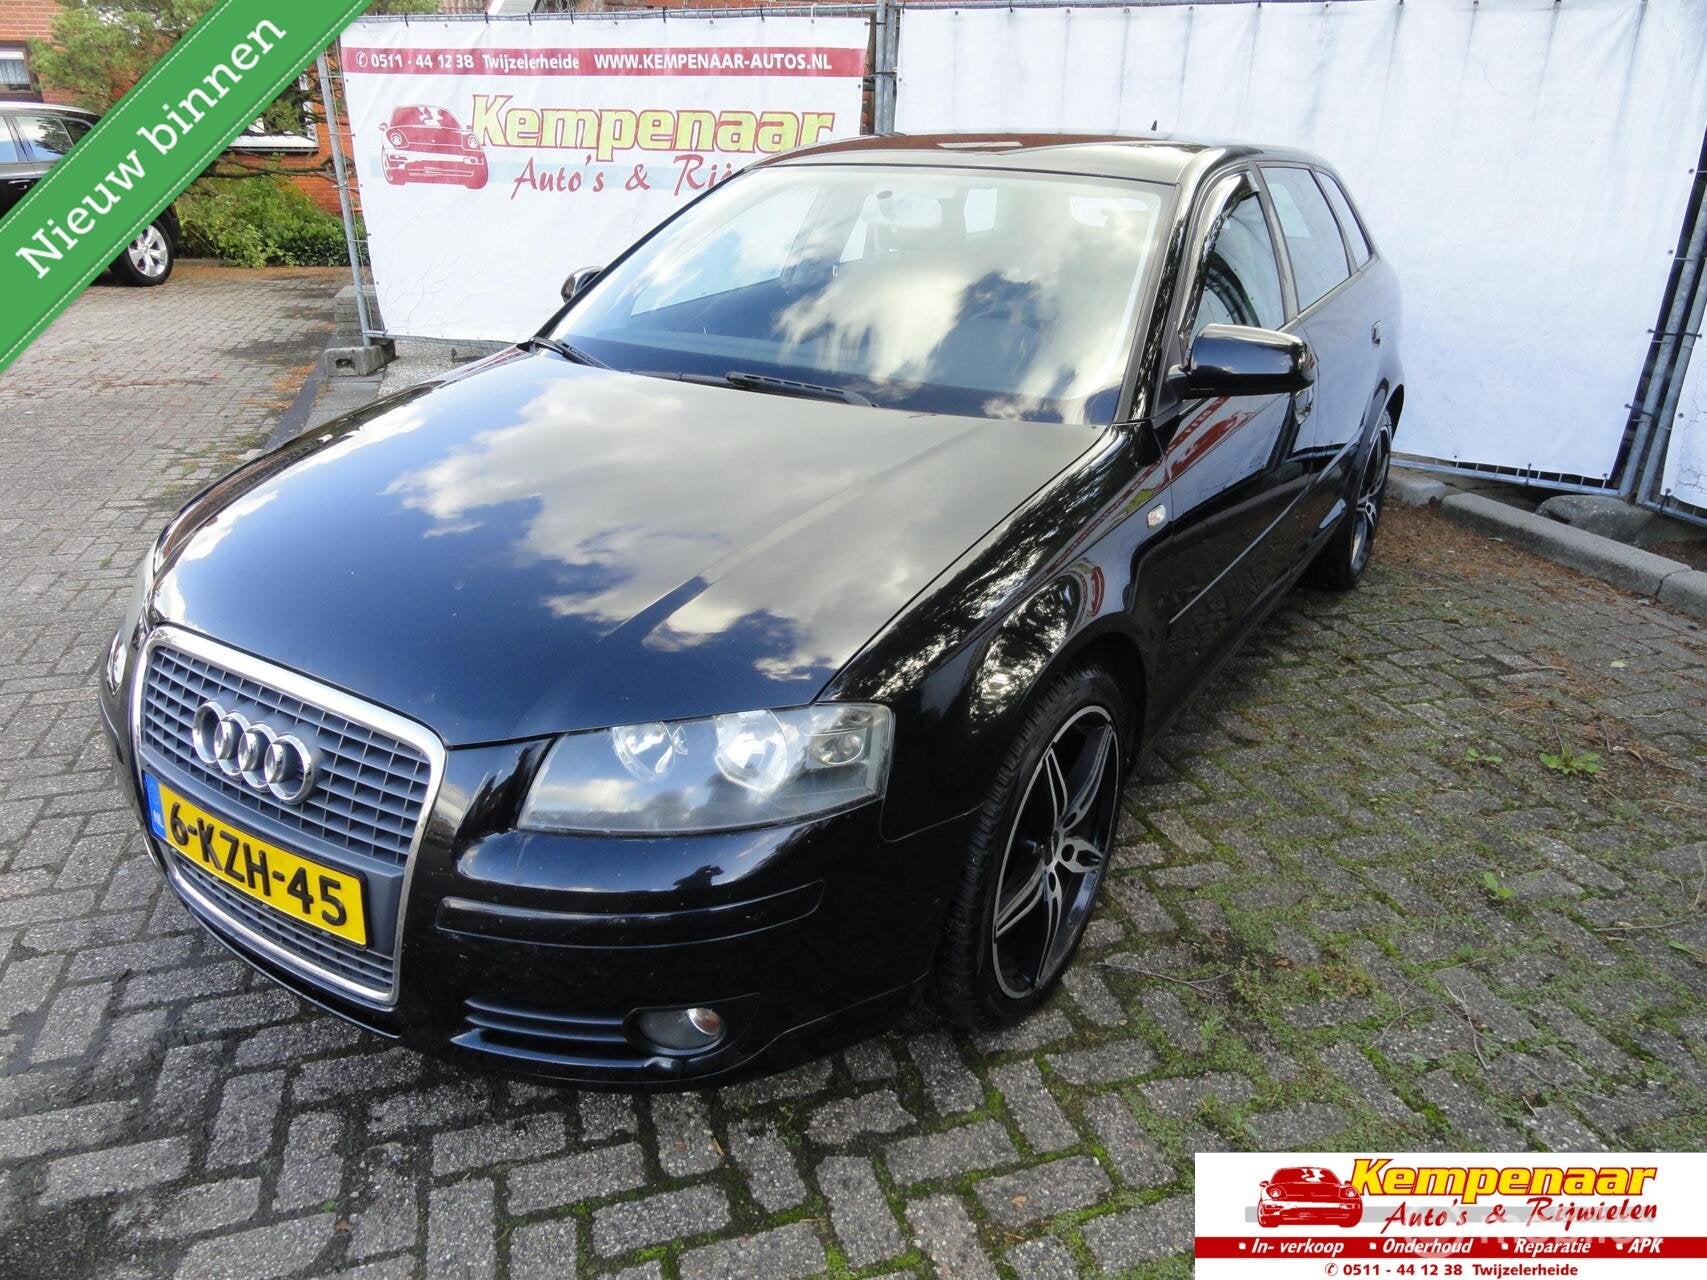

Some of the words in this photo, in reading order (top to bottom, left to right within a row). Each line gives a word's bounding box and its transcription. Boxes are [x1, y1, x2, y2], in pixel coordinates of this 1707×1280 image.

[371, 54, 403, 68] 0511
[415, 54, 433, 68] 44
[437, 55, 452, 68] 12
[456, 54, 474, 68] 38
[482, 54, 580, 73] Twijzelerheide
[593, 53, 833, 70] WWW.KEMPENAAR-AUTOS.NL
[472, 94, 836, 162] Kempenaar
[510, 154, 605, 200] Auto's
[624, 163, 651, 190] &
[169, 802, 347, 926] 6-KZH-45
